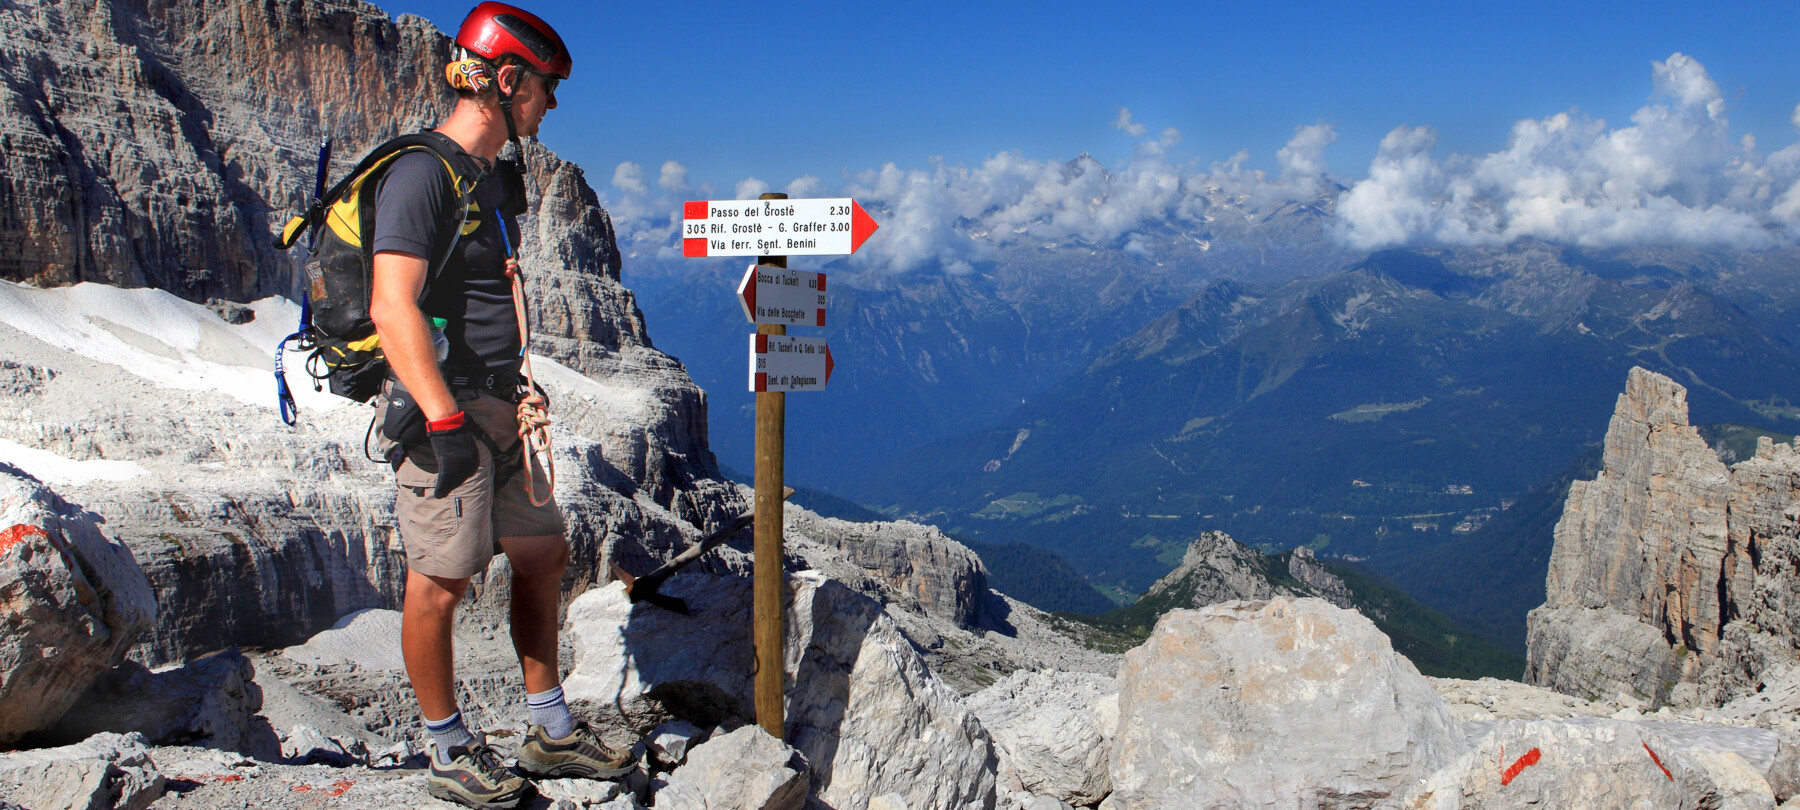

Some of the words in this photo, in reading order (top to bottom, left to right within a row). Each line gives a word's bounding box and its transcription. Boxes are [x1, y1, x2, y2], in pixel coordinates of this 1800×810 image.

[711, 207, 739, 218] Passo
[744, 206, 759, 217] del
[830, 206, 850, 216] 2.30
[686, 224, 706, 234] 305
[710, 223, 727, 234] Rif.
[778, 223, 788, 233] G.
[793, 222, 827, 233] Graffer
[830, 222, 850, 232] 3.00
[710, 240, 726, 250] Via
[731, 239, 752, 249] ferr.
[757, 239, 782, 249] Sent.
[787, 238, 816, 248] Benini
[757, 272, 773, 284] Bocca
[776, 274, 781, 285] di
[757, 306, 765, 317] Via
[768, 307, 780, 318] delle
[782, 308, 805, 319] Bocchette
[794, 345, 798, 353] e
